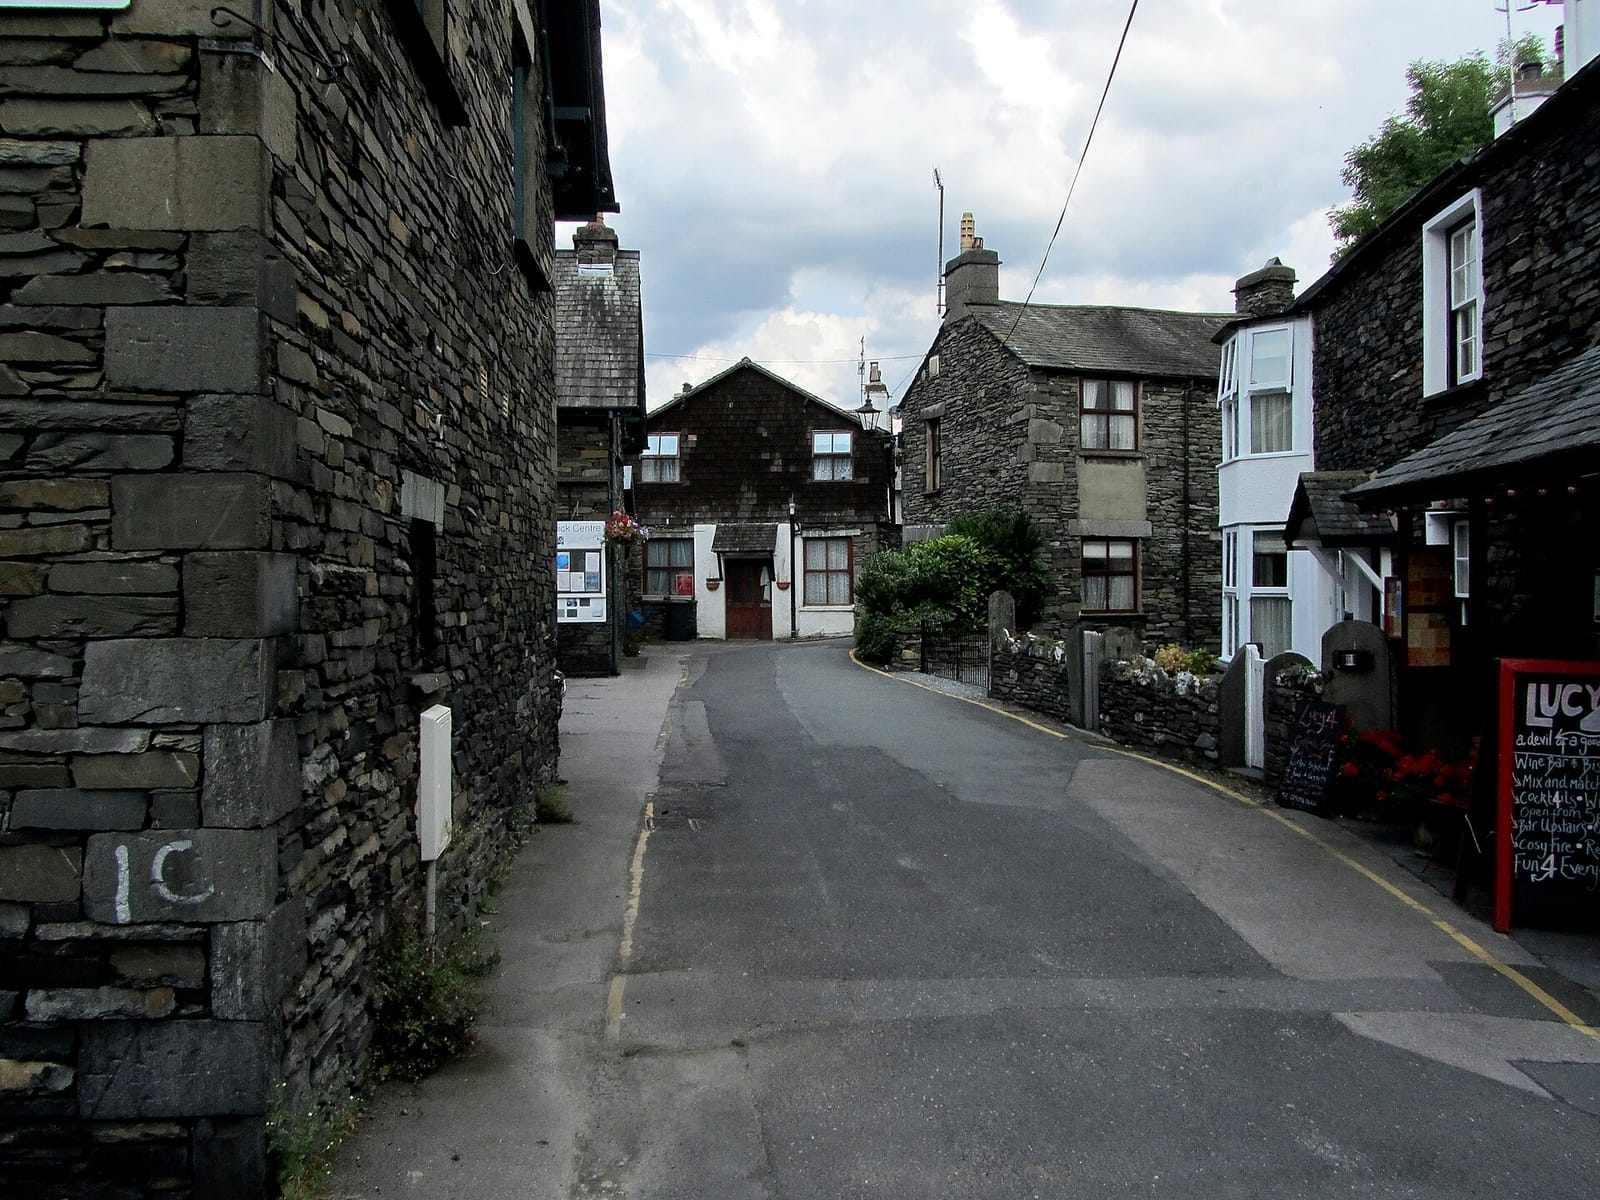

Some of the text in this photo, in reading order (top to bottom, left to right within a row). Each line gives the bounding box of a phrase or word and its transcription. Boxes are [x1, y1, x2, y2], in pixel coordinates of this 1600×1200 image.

[572, 523, 601, 533] Centre
[1527, 730, 1553, 746] devil
[1568, 736, 1578, 747] a
[1579, 736, 1600, 756] goo
[1514, 753, 1545, 770] Wine
[1546, 755, 1568, 774] Bar
[1520, 807, 1549, 820] Open
[1517, 819, 1538, 836] Bar
[1541, 818, 1587, 837] Upstairs
[1513, 852, 1539, 876] Fun
